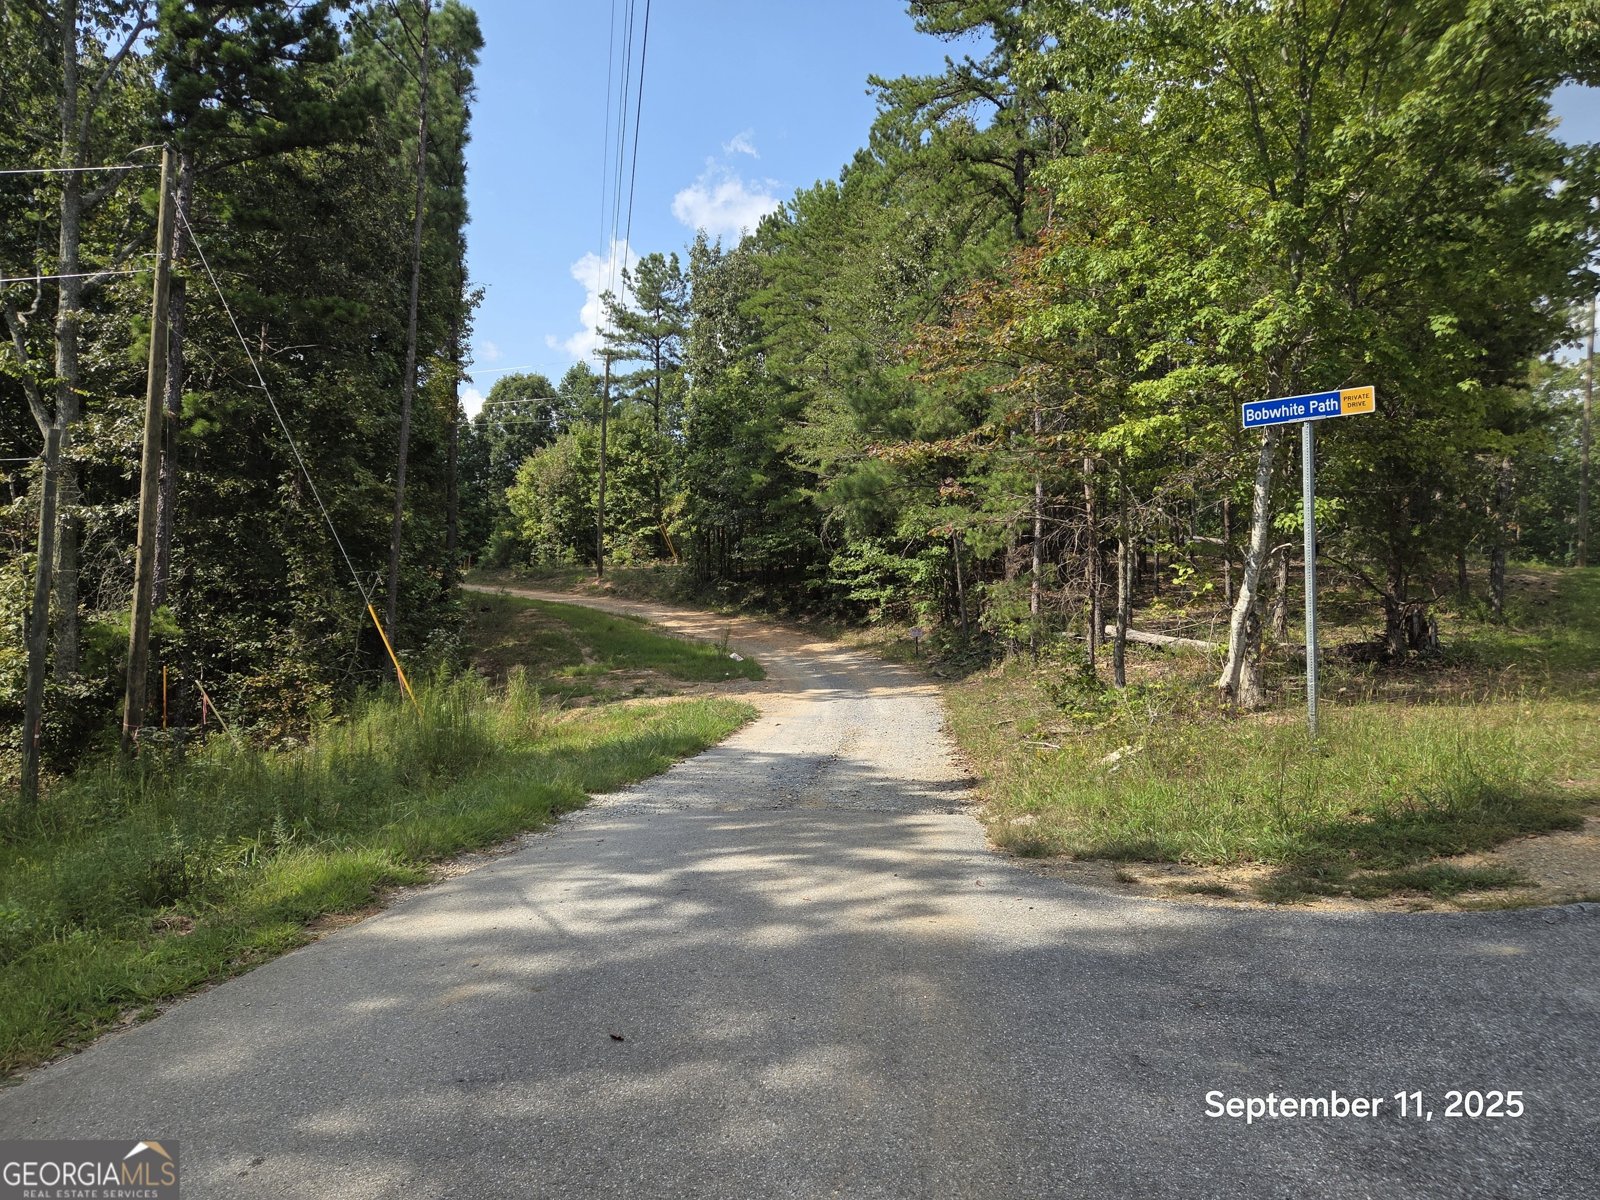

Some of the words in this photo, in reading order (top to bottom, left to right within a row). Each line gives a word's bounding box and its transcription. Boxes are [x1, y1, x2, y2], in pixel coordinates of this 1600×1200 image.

[1343, 393, 1370, 402] PRIVATE
[1347, 400, 1366, 408] DRIVE
[1246, 403, 1305, 422] Bobwhite
[1310, 398, 1339, 414] Path
